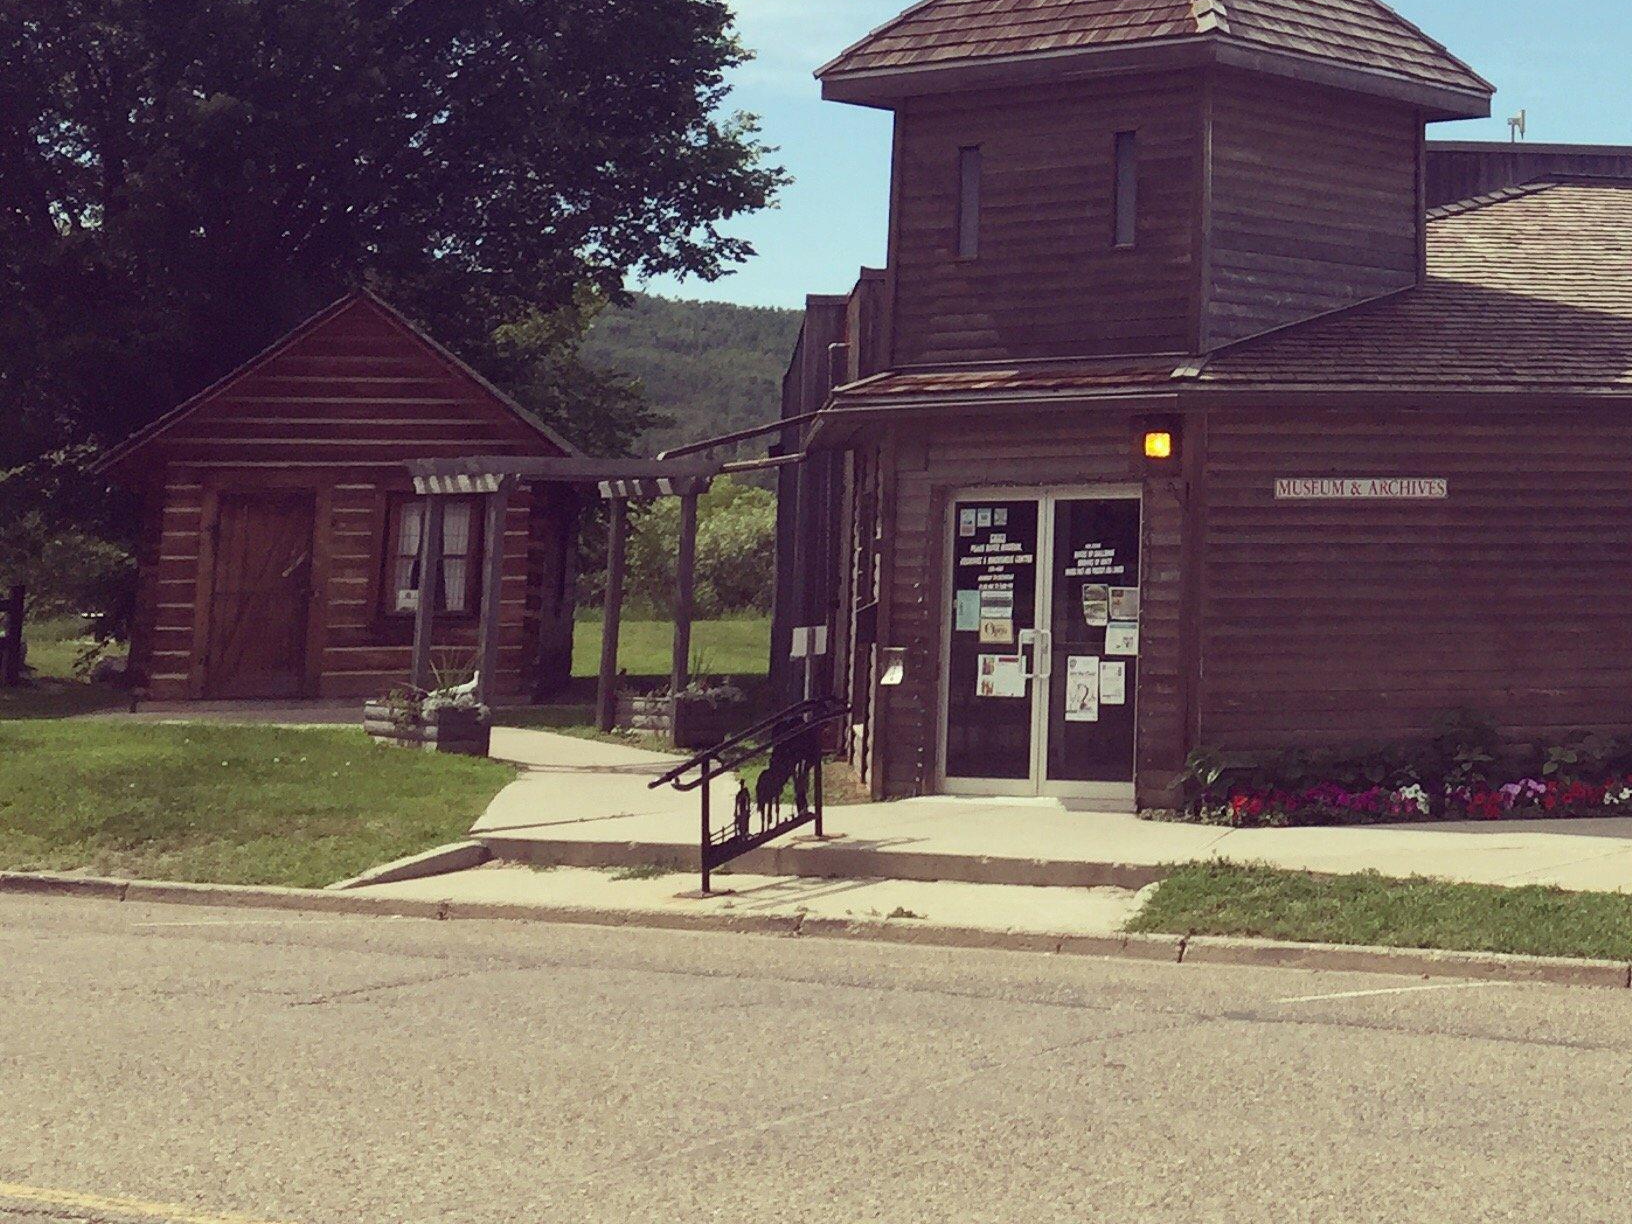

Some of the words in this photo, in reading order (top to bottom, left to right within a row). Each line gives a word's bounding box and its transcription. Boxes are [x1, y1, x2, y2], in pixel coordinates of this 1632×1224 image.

[1278, 480, 1344, 496] MUSEUM
[1350, 481, 1361, 496] &
[1368, 479, 1446, 496] ARCHIVES
